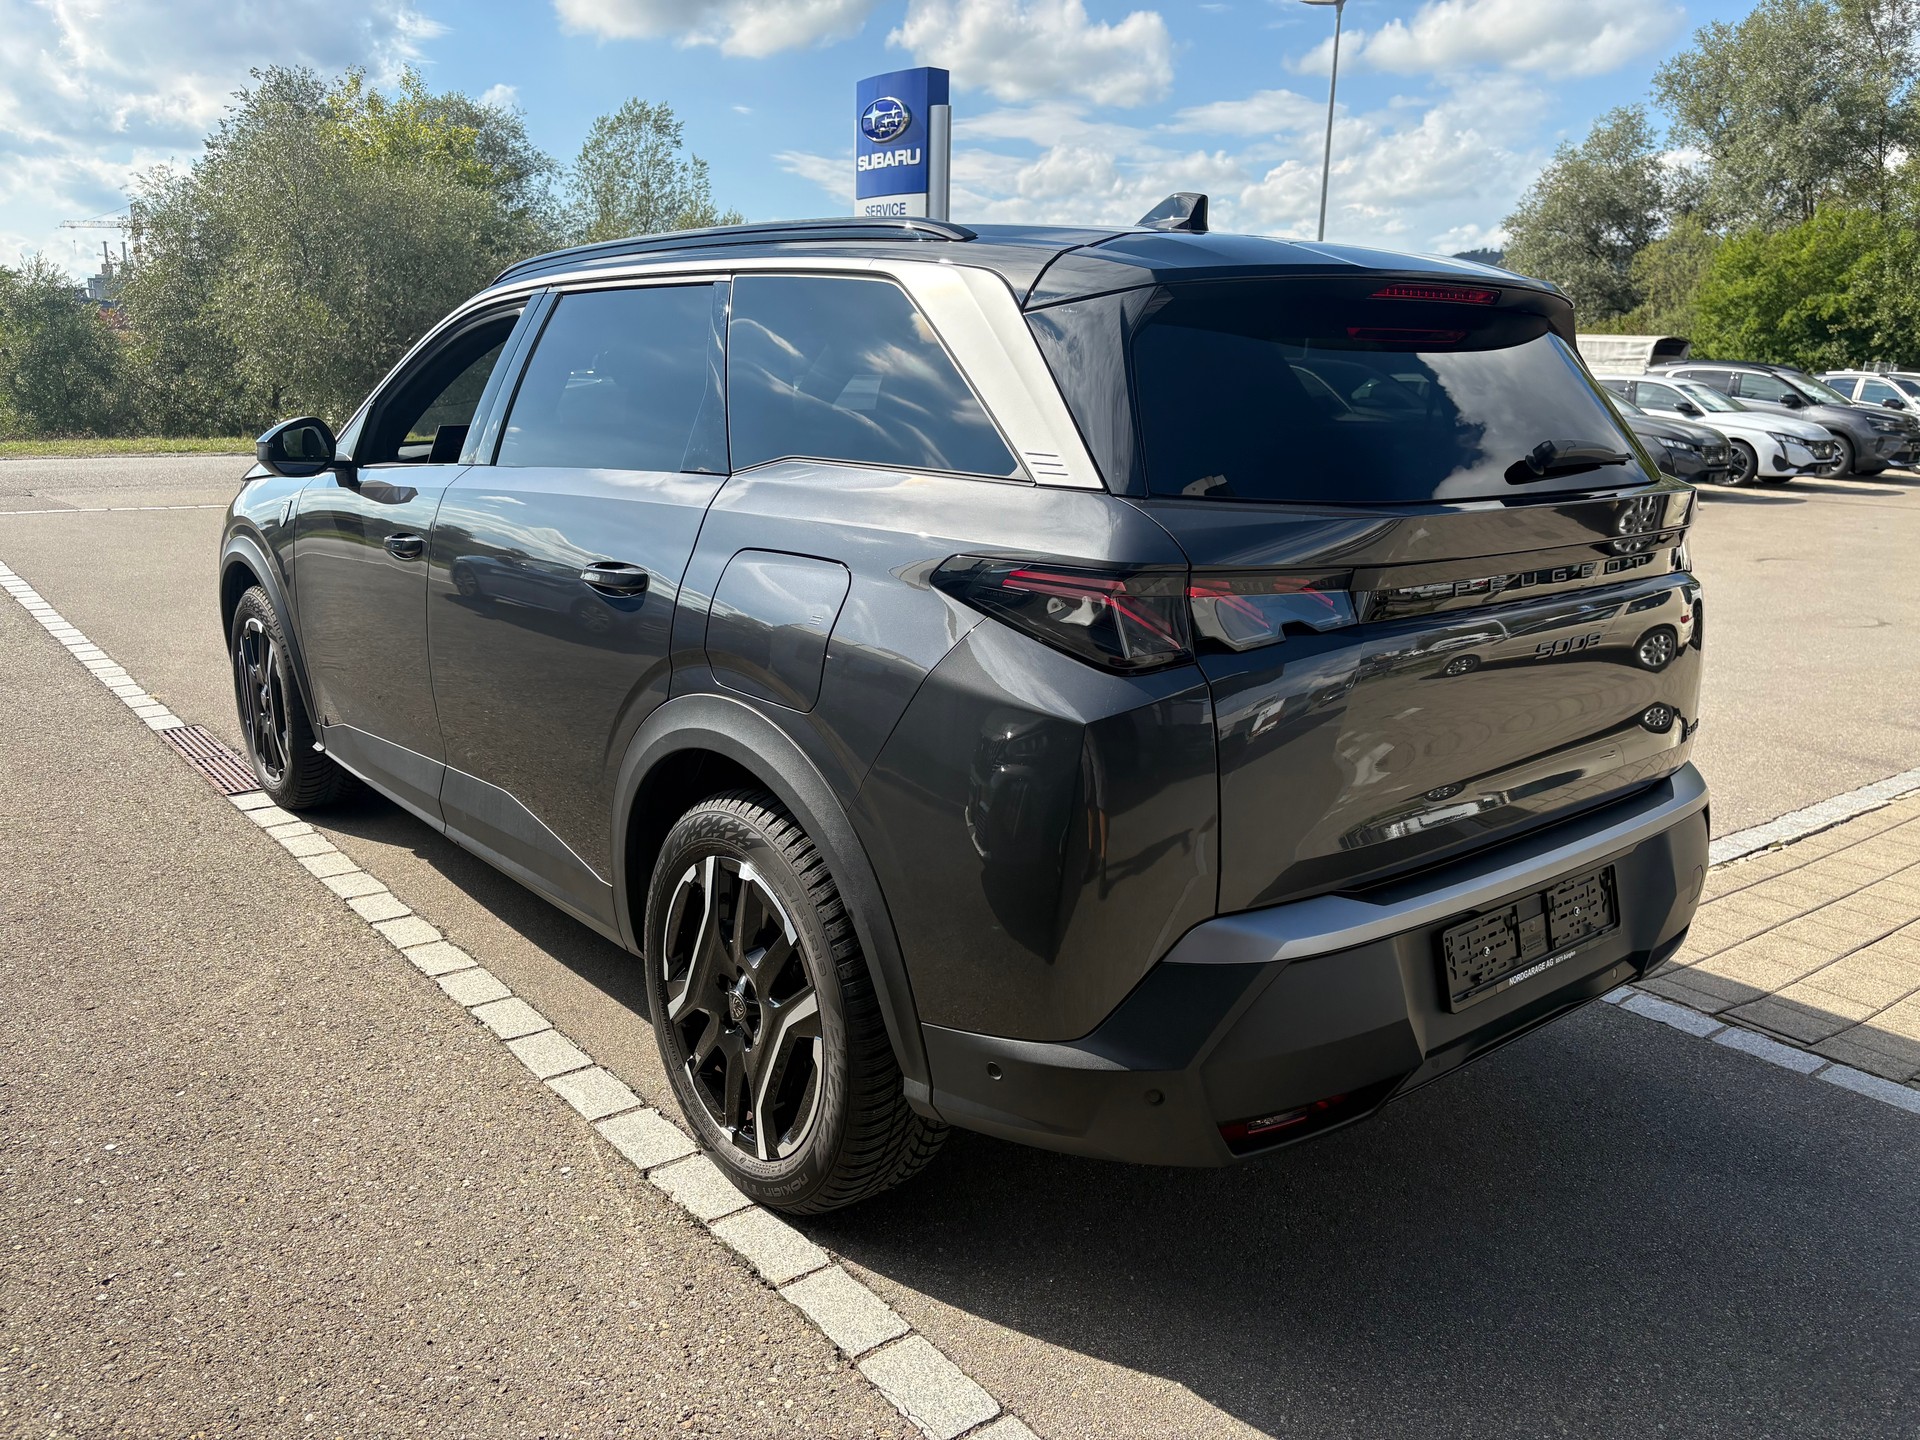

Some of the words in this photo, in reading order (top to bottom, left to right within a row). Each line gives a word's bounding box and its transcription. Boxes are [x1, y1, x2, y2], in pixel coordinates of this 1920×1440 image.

[858, 148, 920, 171] SUBARU
[865, 202, 906, 217] SERVICE
[1454, 556, 1646, 596] PEUGEOT
[1535, 633, 1602, 660] 5008
[1509, 961, 1546, 986] NORDGARAGE
[1546, 958, 1554, 969] AG
